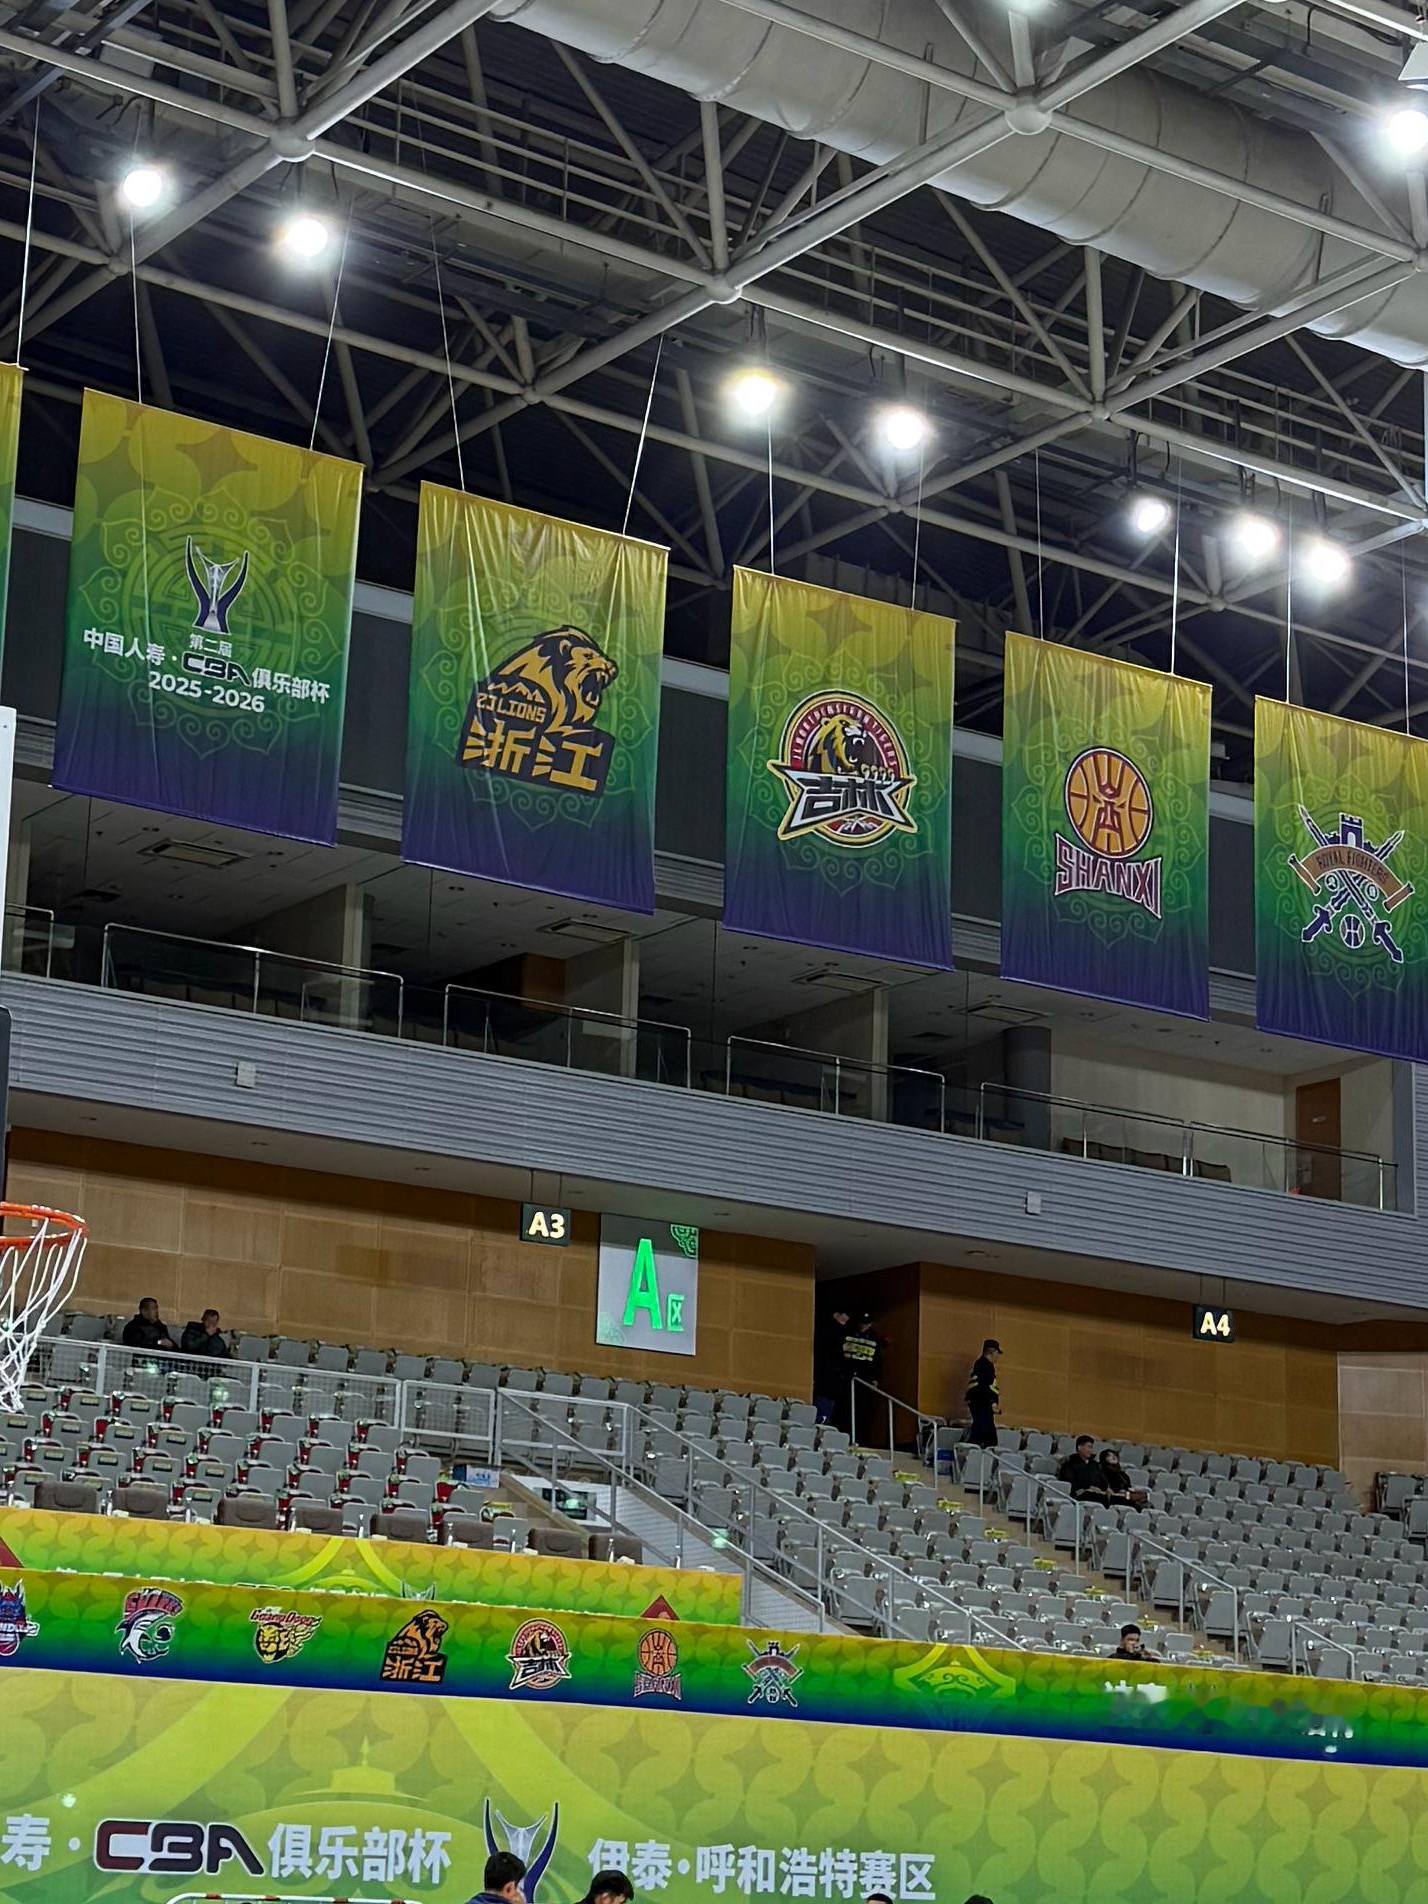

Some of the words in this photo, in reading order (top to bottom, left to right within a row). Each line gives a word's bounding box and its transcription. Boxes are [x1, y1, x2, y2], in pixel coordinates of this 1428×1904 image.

[189, 633, 232, 657] 第二届
[149, 673, 265, 714] 2025-2026
[463, 717, 603, 791] 浙江
[1056, 835, 1161, 918] SHANXI
[528, 1211, 565, 1238] A3
[1200, 1312, 1230, 1337] A4
[382, 1655, 442, 1682] 浙江
